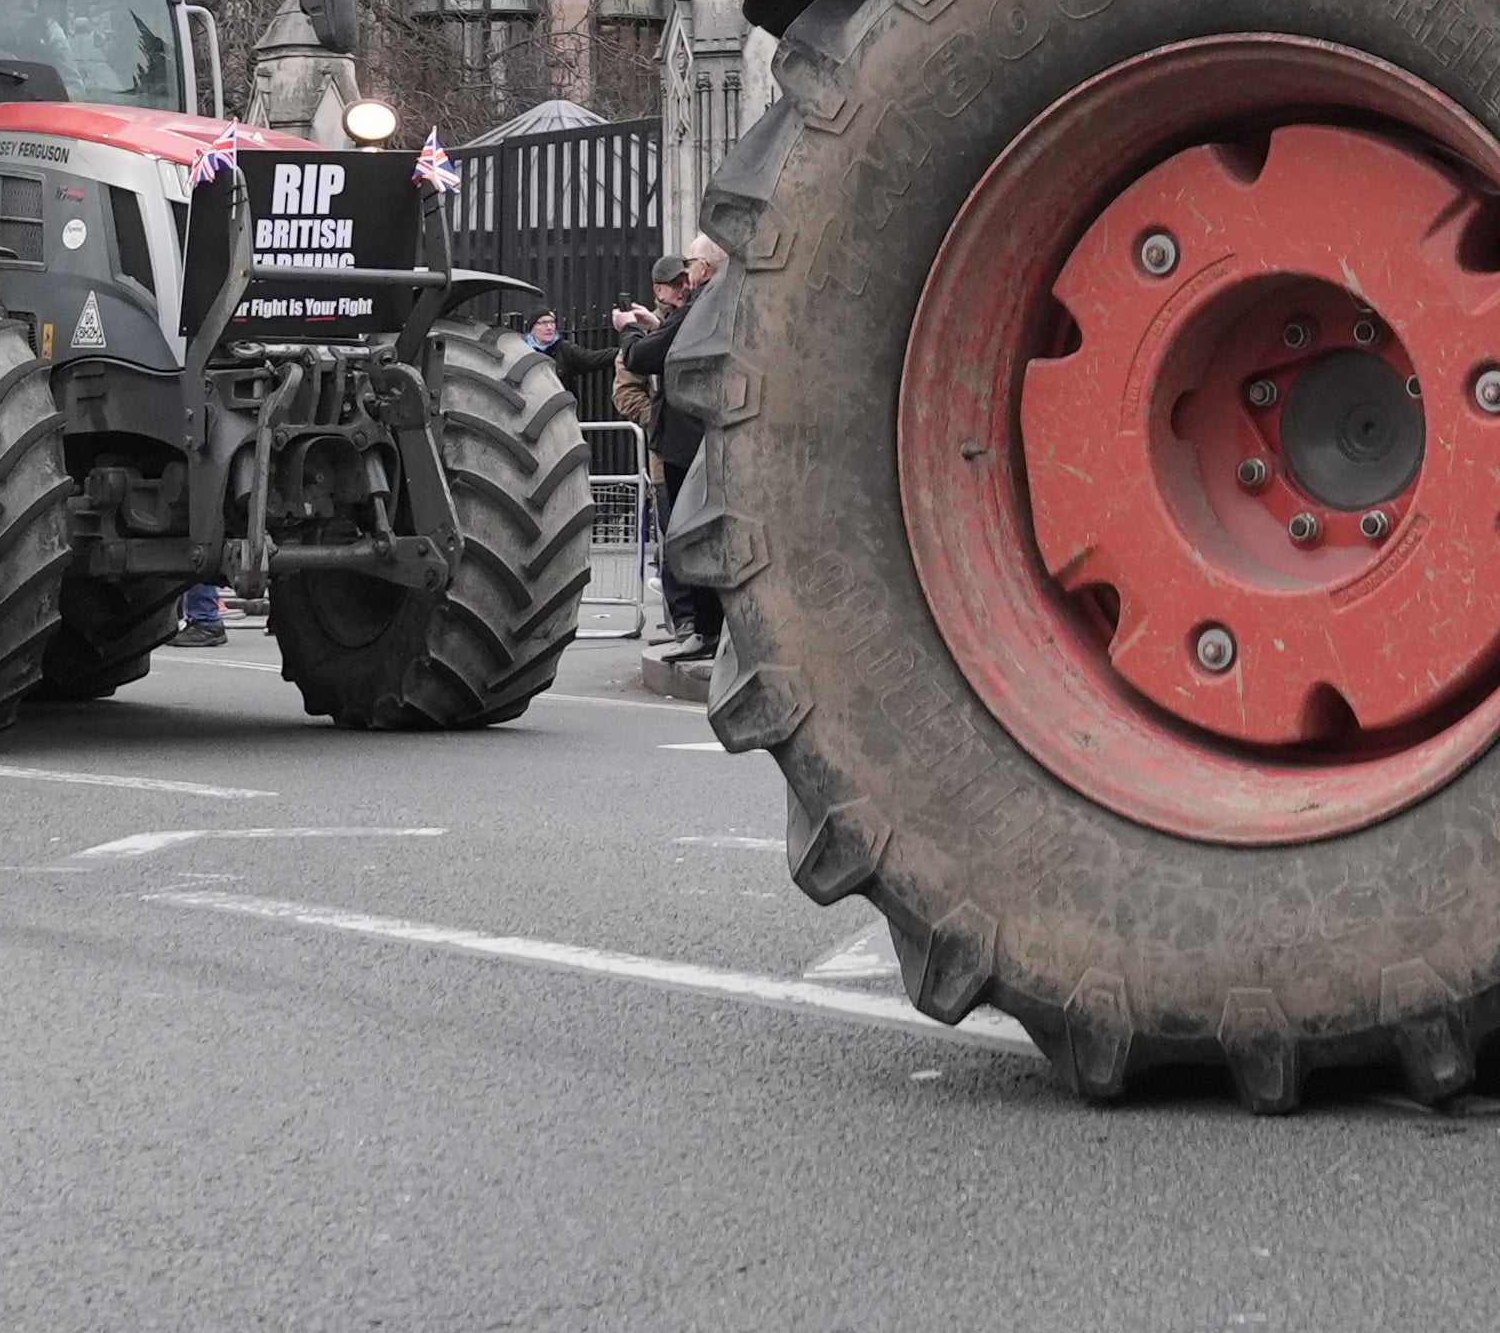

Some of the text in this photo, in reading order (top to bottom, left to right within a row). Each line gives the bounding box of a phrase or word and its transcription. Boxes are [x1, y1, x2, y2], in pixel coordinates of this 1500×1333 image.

[17, 142, 70, 164] FERGUSON
[271, 163, 346, 215] RIP
[255, 218, 353, 249] BRITISH
[251, 298, 288, 318] Fight
[305, 297, 337, 317] Your
[338, 297, 373, 318] Fight
